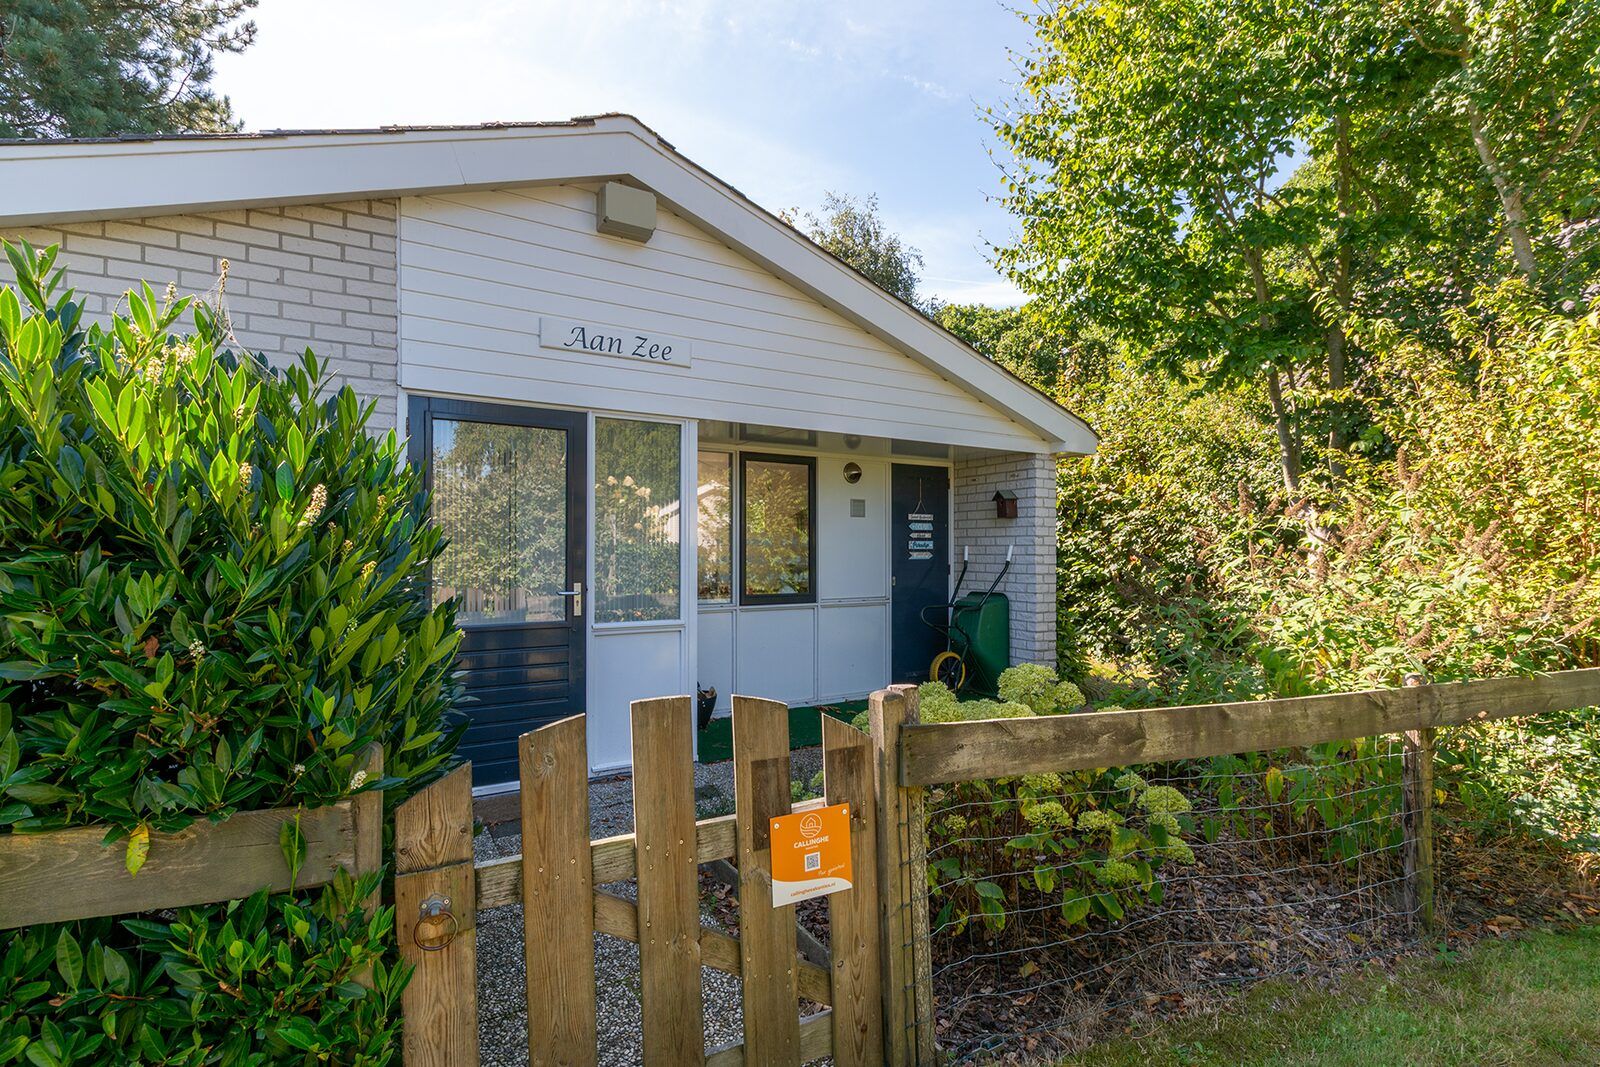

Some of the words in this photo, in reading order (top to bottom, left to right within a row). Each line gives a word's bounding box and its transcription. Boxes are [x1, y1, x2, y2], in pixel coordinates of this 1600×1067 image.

[563, 326, 623, 354] Aan
[631, 335, 673, 361] Zee
[793, 835, 830, 849] CALLINGHE
